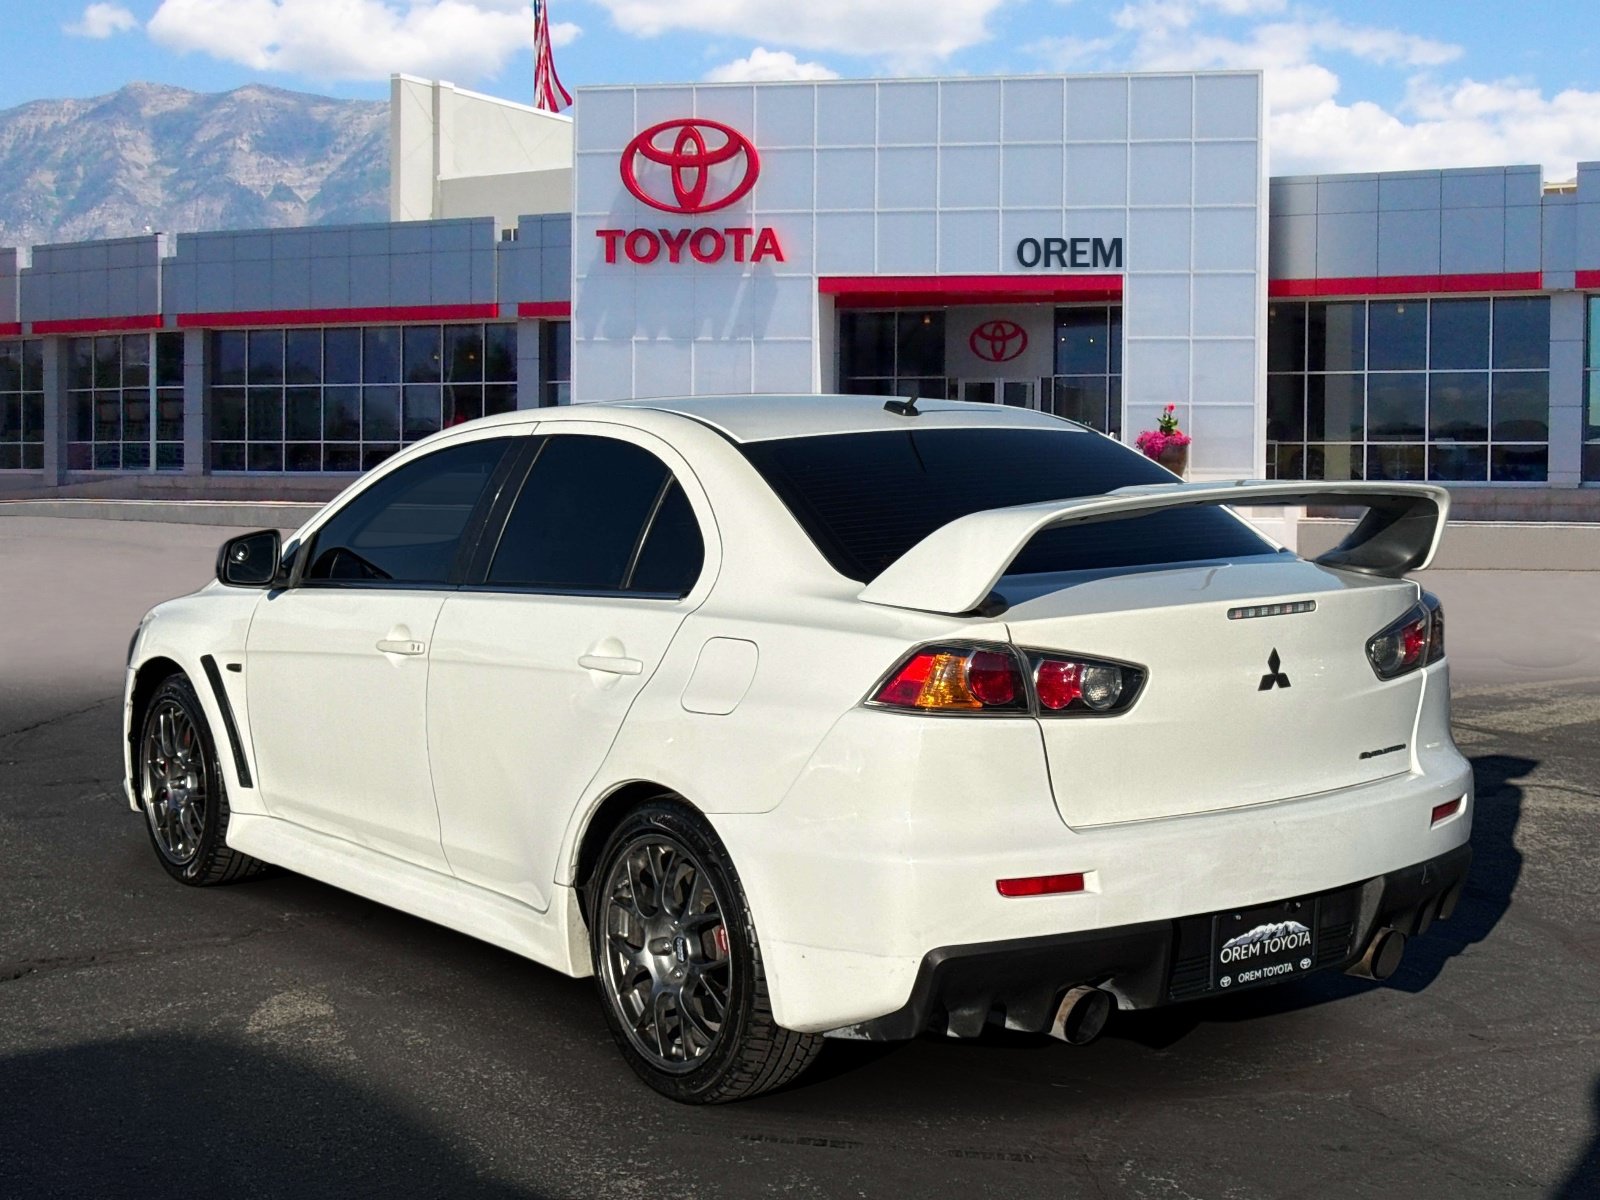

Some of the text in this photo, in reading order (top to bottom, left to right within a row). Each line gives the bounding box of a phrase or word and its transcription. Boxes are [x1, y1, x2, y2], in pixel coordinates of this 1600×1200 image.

[596, 227, 785, 264] TOYOTA
[1016, 237, 1123, 269] OREM
[1220, 931, 1311, 964] OREM TOYOTA
[1238, 963, 1293, 984] OREM TOYOTA
